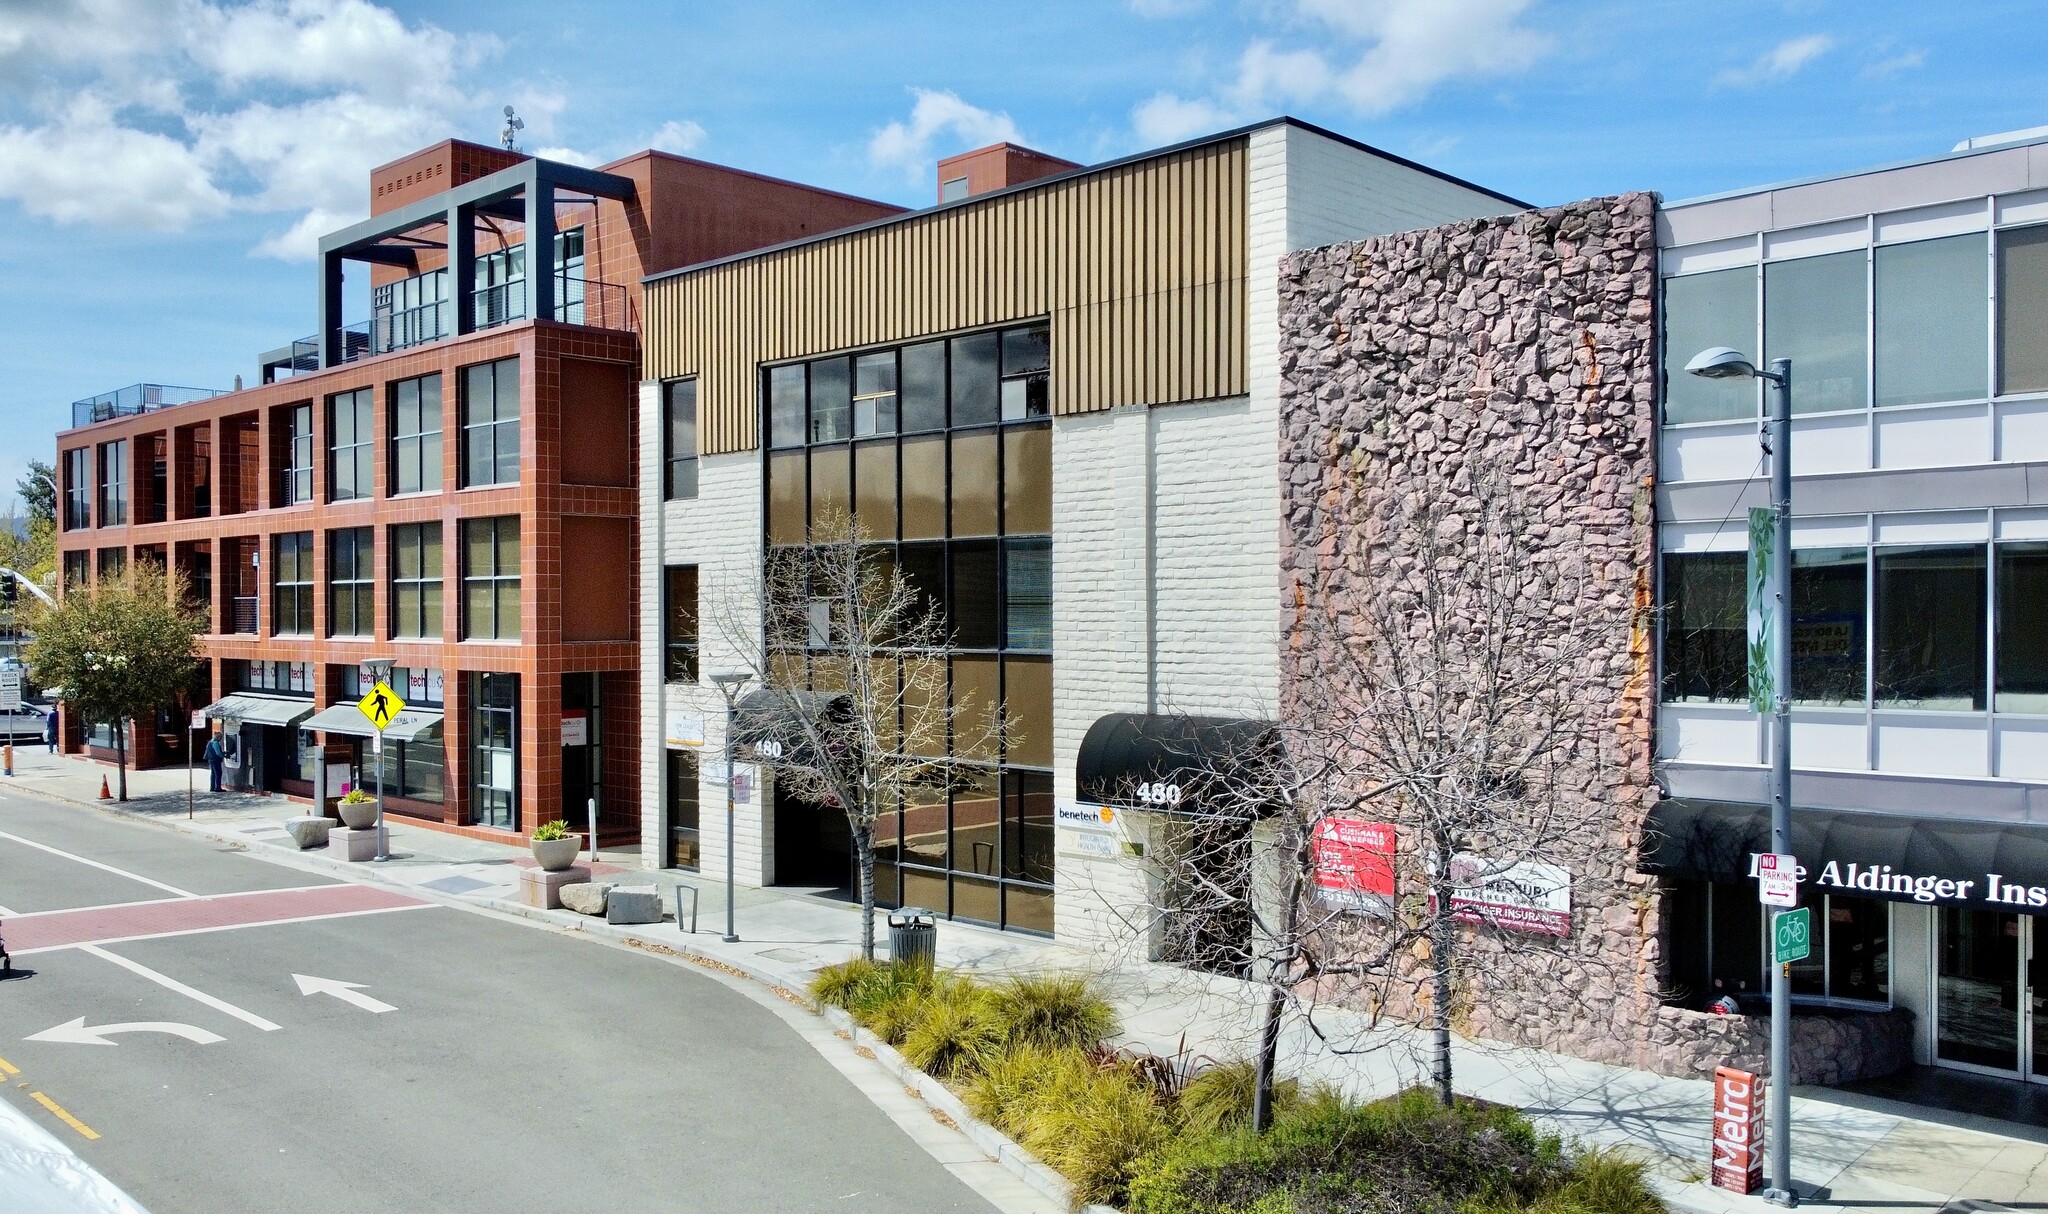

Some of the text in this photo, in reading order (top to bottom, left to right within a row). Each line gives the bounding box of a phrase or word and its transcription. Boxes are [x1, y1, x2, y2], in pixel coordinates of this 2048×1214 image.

[410, 674, 426, 687] tech
[754, 740, 782, 757] 480
[1136, 782, 1181, 804] 480
[1059, 808, 1099, 823] benetech
[1339, 827, 1377, 838] CUSHMAN
[1340, 835, 1385, 846] WAKEFIELD
[1762, 856, 1775, 866] NO
[1763, 869, 1793, 882] PARKING
[1816, 860, 1974, 902] Aldinger
[1985, 873, 2048, 907] Ins
[1505, 908, 1563, 924] INSURANCE
[1777, 944, 1807, 961] BIKE ROUTE
[1714, 1079, 1750, 1174] Metro
[1748, 1078, 1765, 1172] Metro
